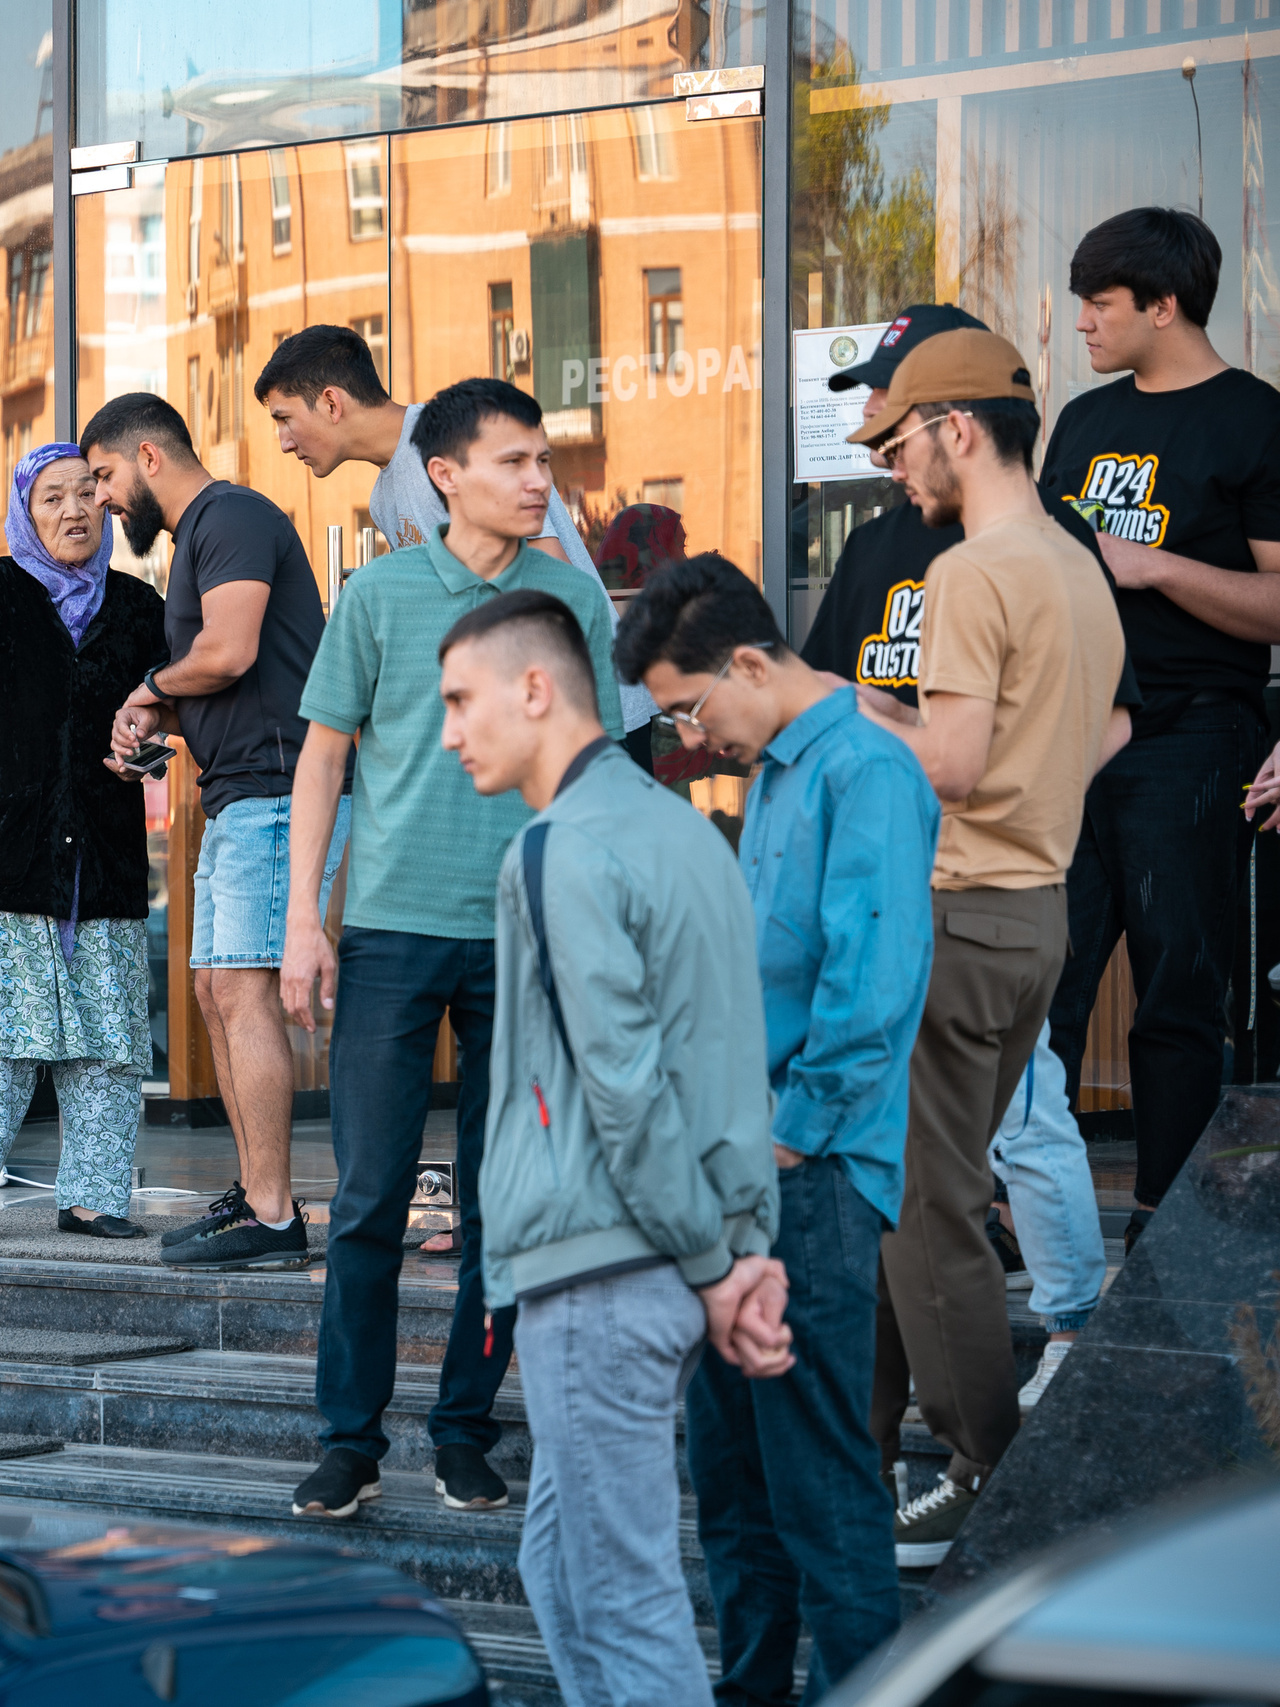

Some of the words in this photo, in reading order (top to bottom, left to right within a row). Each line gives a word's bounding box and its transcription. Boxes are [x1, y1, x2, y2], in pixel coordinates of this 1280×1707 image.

[1086, 458, 1154, 506] 024
[1103, 507, 1162, 543] TOMS
[888, 586, 926, 640] 02
